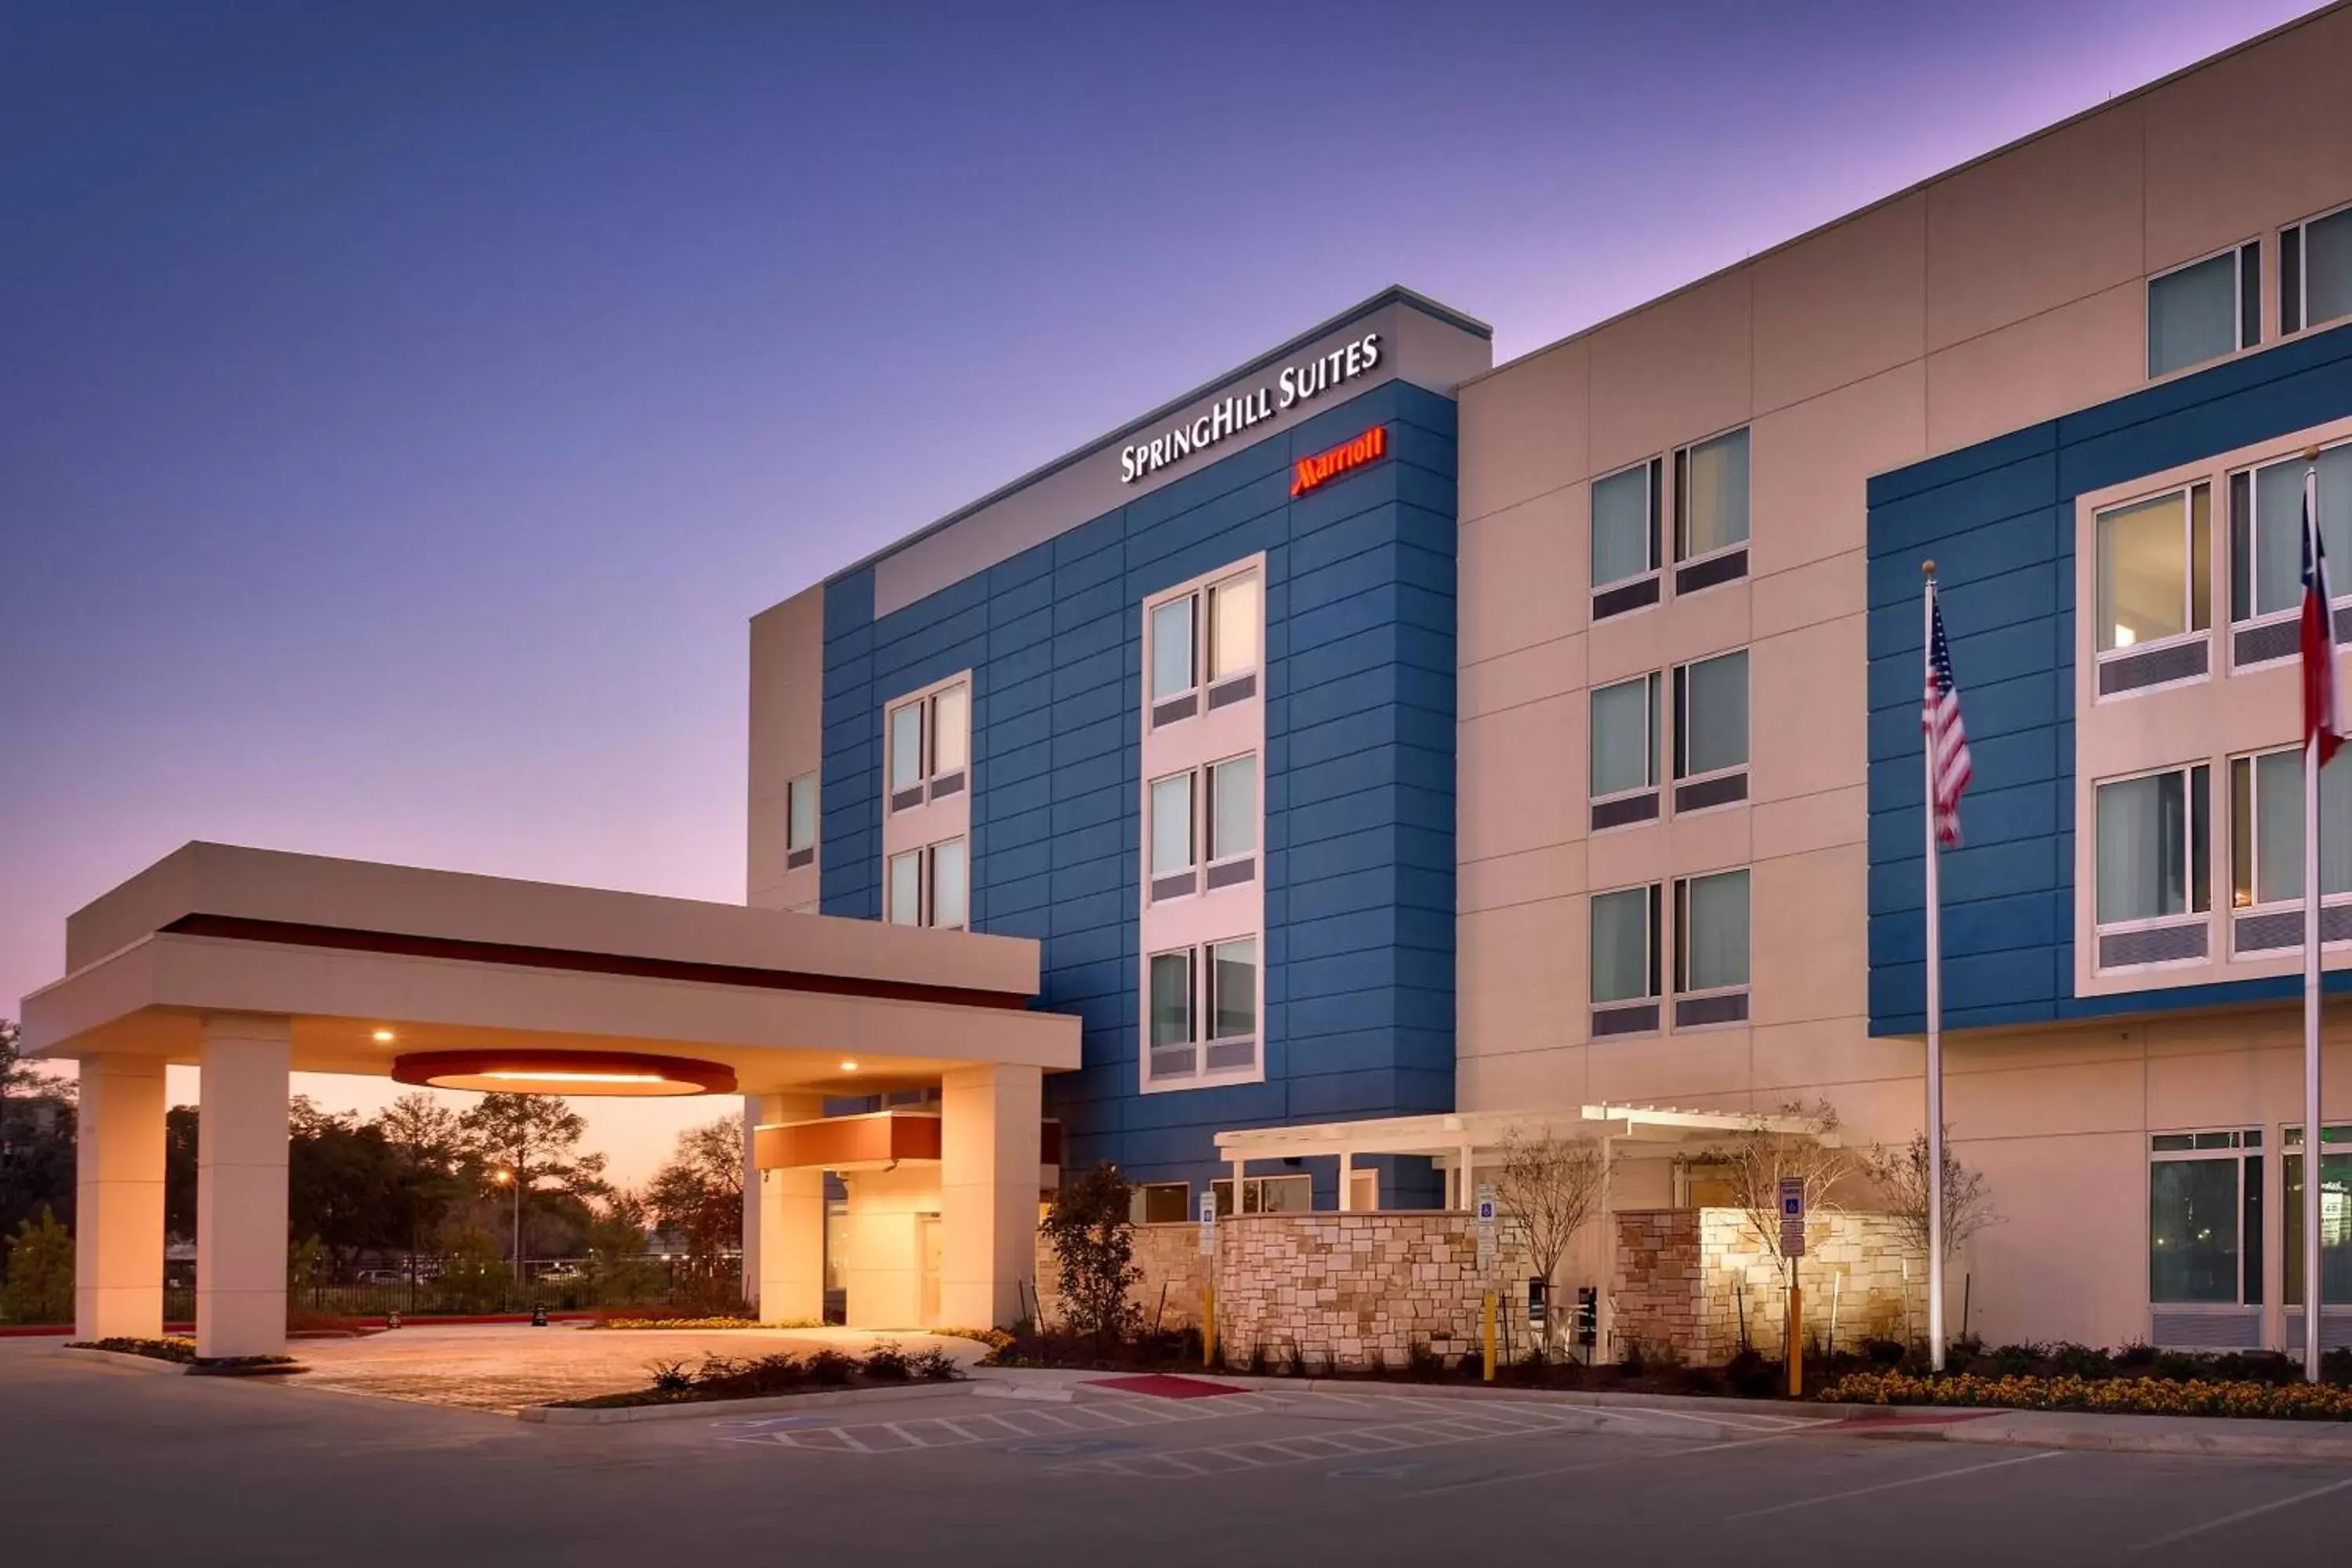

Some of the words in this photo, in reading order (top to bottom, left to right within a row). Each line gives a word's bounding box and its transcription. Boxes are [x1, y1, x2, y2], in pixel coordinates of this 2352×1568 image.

[1121, 388, 1272, 483] SPRINGHILL
[1279, 333, 1378, 408] SUITES
[1290, 426, 1387, 496] Marriott
